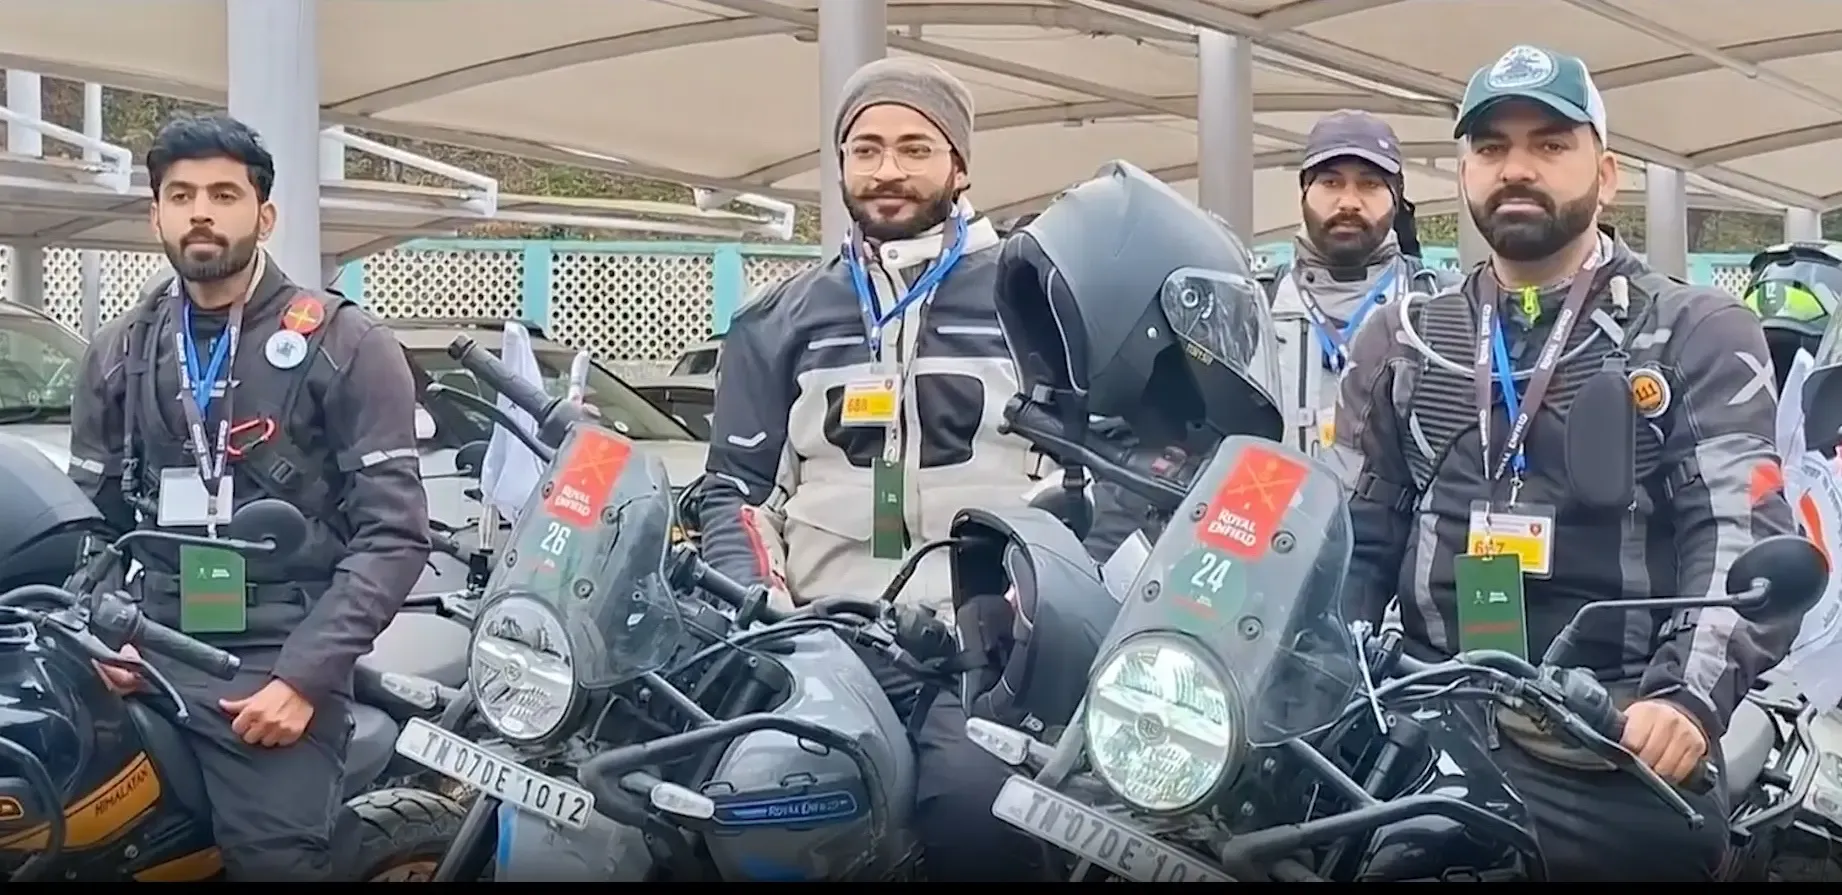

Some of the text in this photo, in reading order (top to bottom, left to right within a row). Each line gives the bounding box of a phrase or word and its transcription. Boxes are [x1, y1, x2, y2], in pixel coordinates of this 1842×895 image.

[1635, 382, 1658, 402] 111
[1208, 521, 1256, 547] ENFIELD
[1217, 508, 1256, 532] ROYAL
[540, 521, 571, 556] 26
[1191, 552, 1232, 593] 24
[522, 778, 587, 824] 1012
[1152, 853, 1208, 882] 10
